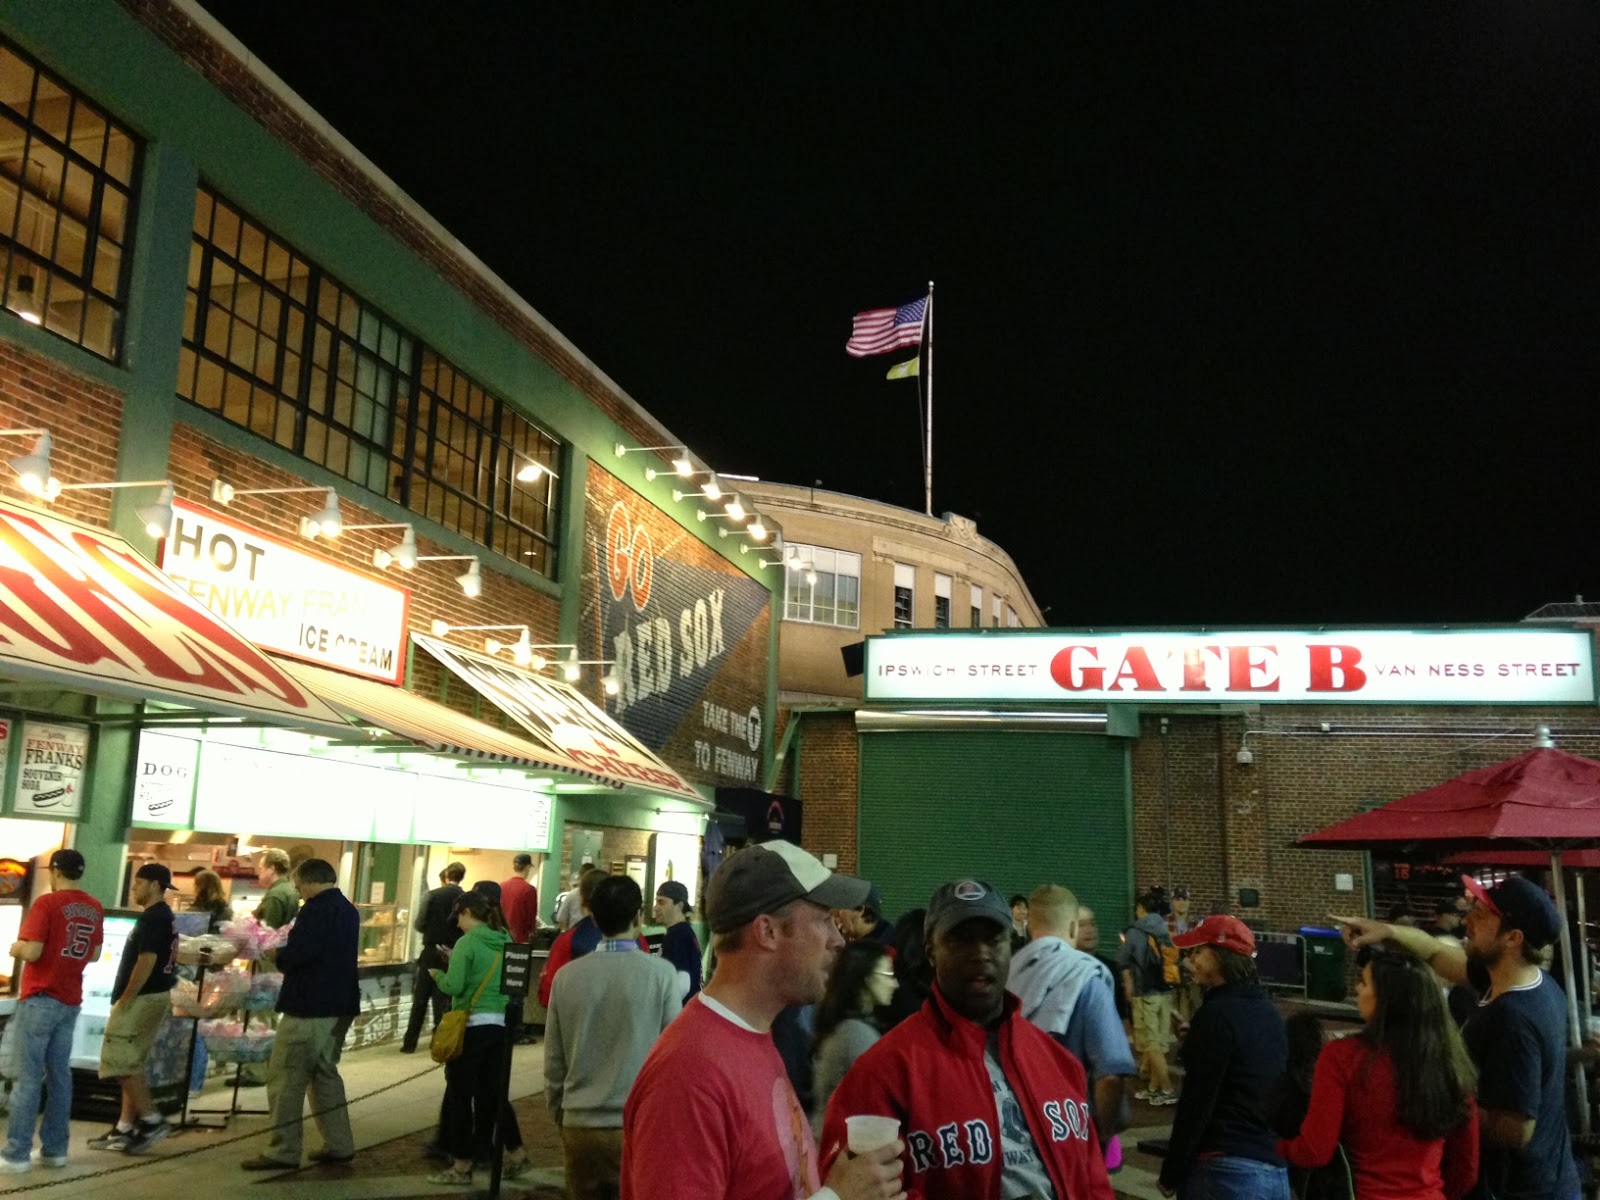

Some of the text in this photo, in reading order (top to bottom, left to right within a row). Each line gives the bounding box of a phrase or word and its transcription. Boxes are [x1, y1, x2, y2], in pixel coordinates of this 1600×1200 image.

[172, 516, 266, 581] HOT
[606, 500, 653, 613] GO
[298, 622, 329, 654] ICE
[614, 589, 725, 714] RED SOX
[878, 664, 1038, 677] IPSWICH STREET
[1050, 644, 1368, 693] GATE B
[1375, 663, 1581, 677] VAN NESS STREET
[703, 700, 728, 734] TAKE
[730, 711, 747, 741] THE
[24, 749, 83, 770] FRANKS
[27, 738, 84, 756] FENWAY
[694, 740, 759, 782] TO FENWAY
[142, 762, 188, 779] DOG
[61, 921, 95, 960] 15
[908, 1119, 992, 1174] RED
